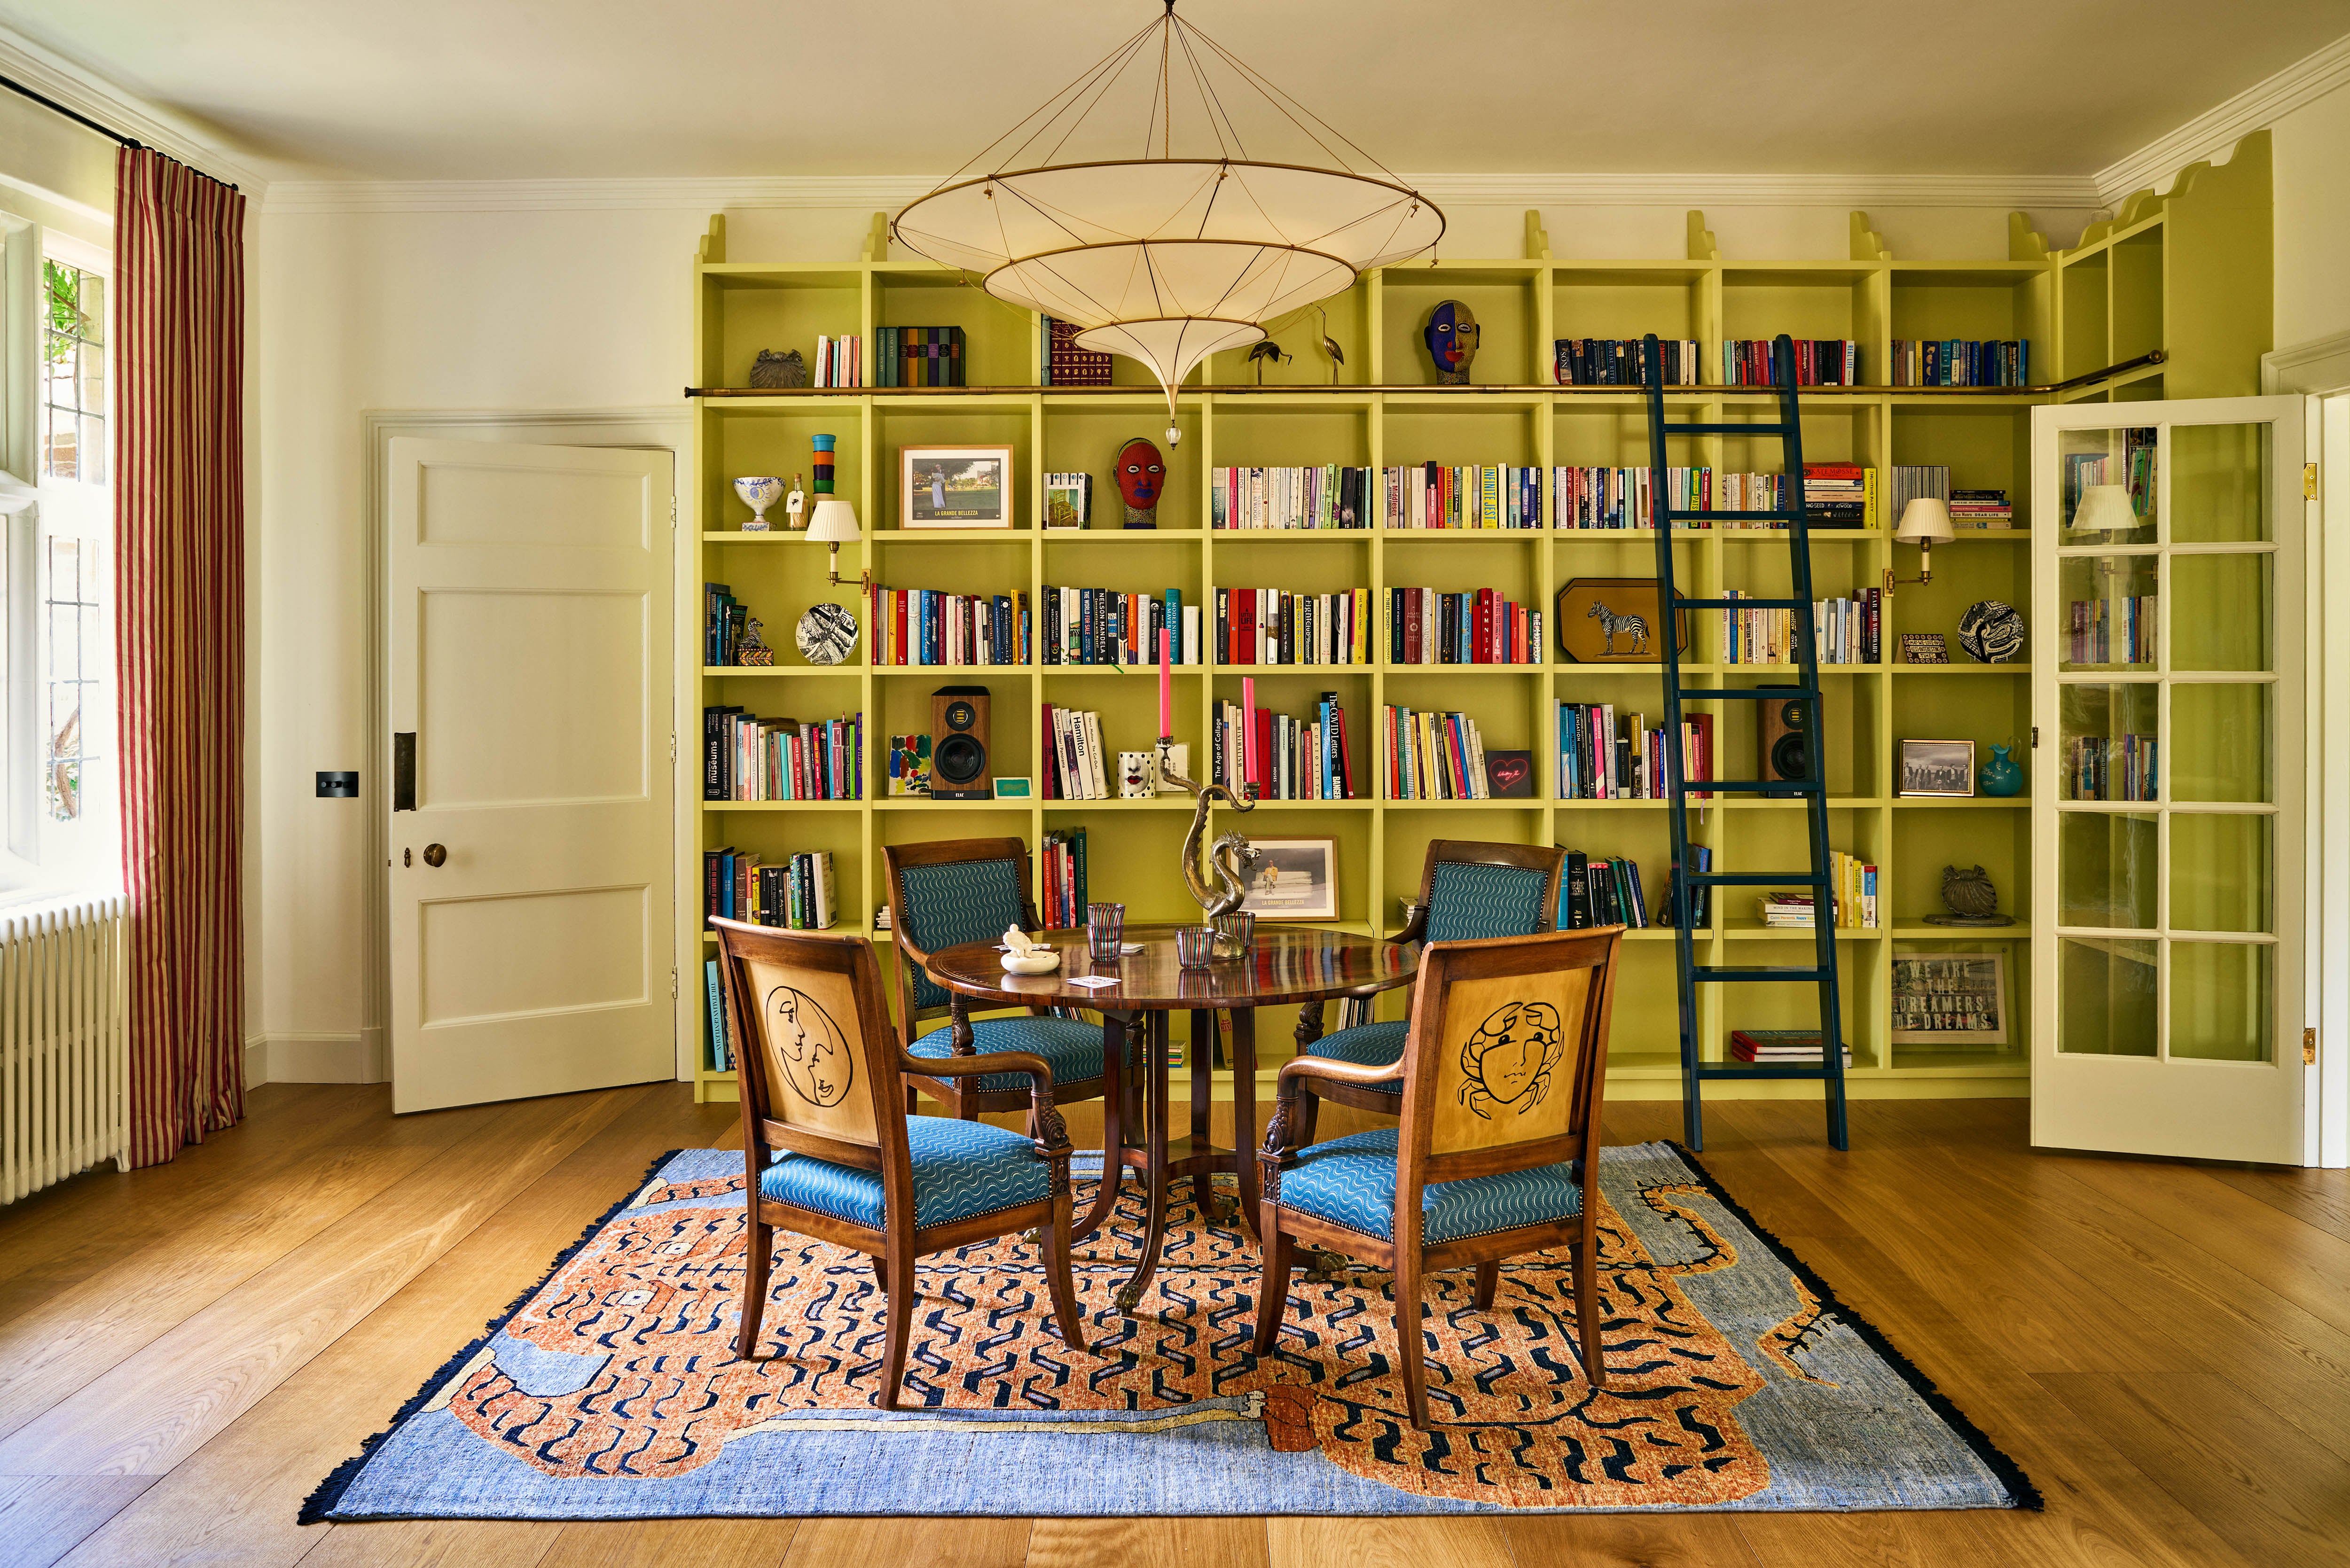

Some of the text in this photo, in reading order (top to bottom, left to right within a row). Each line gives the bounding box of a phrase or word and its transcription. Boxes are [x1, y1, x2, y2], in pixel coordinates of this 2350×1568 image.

[1484, 469, 1496, 520] INFINITE JEST
[1330, 708, 1339, 735] COVID
[1073, 717, 1084, 756] Hamilton
[1910, 961, 1970, 977] WE ARE
[1927, 979, 1954, 994] THE
[1900, 996, 1983, 1012] DREAMERS
[1924, 1013, 1988, 1029] DREAMS
